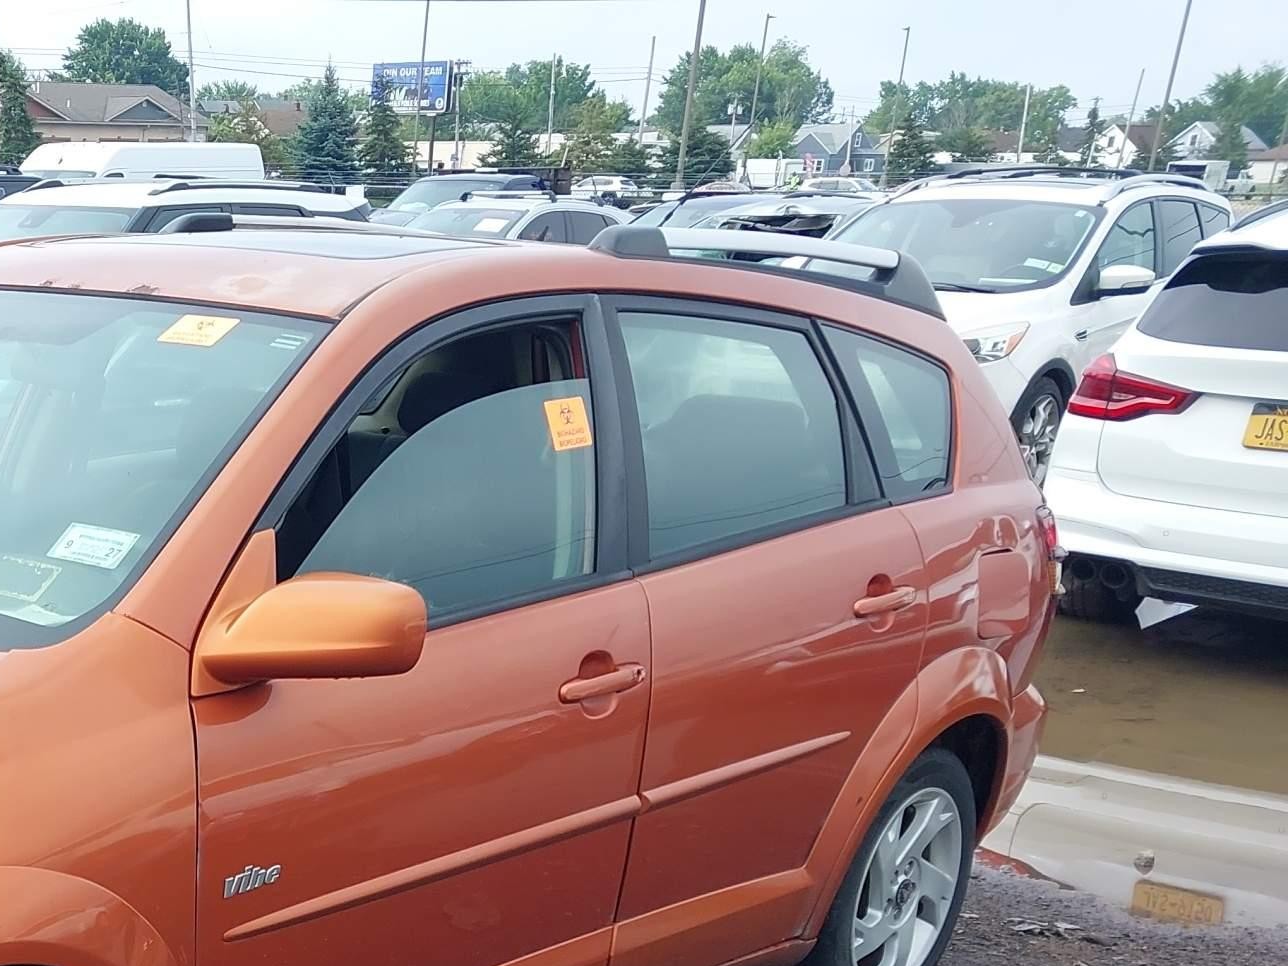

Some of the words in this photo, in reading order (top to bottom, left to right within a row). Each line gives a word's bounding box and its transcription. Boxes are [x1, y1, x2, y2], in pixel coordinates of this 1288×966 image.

[399, 67, 418, 76] OUR
[1255, 418, 1288, 441] JAS
[104, 547, 123, 559] 27
